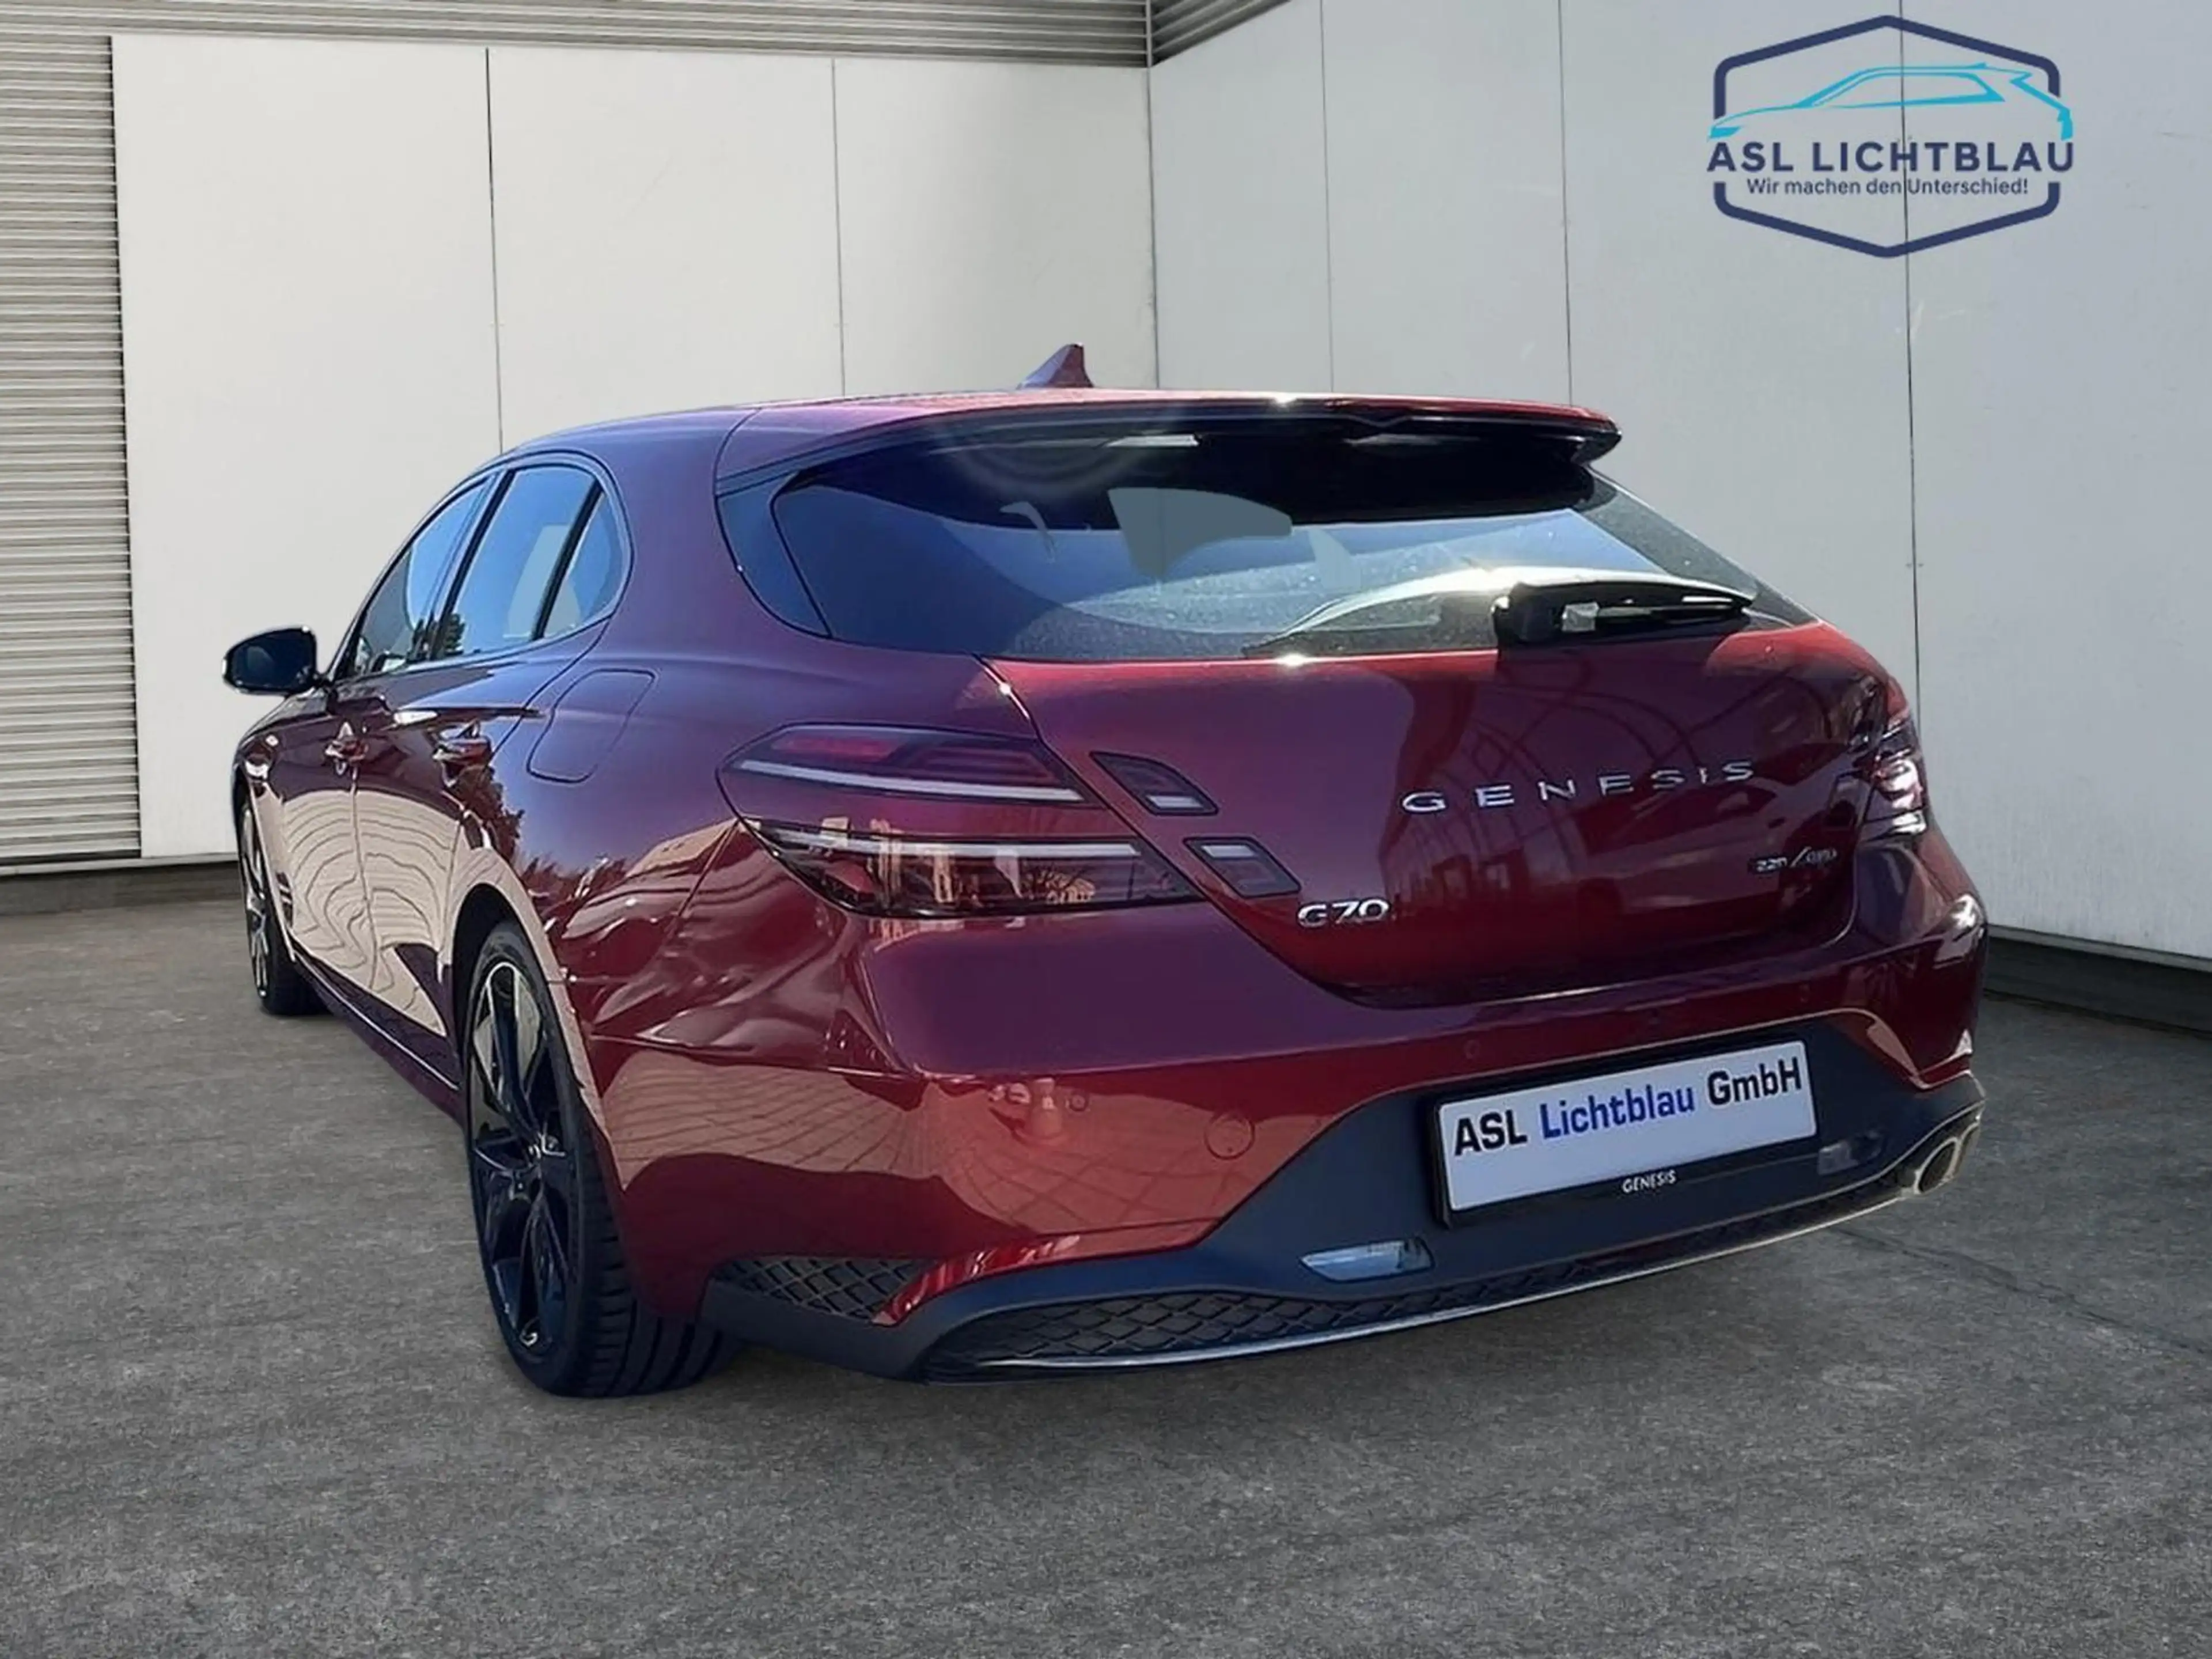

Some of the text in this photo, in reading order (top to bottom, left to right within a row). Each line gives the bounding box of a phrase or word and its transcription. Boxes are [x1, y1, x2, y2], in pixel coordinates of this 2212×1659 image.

[1402, 760, 1753, 813] GENESIS
[1298, 897, 1389, 927] G70
[1454, 1057, 1802, 1156] ASL Lichtblau GmbH
